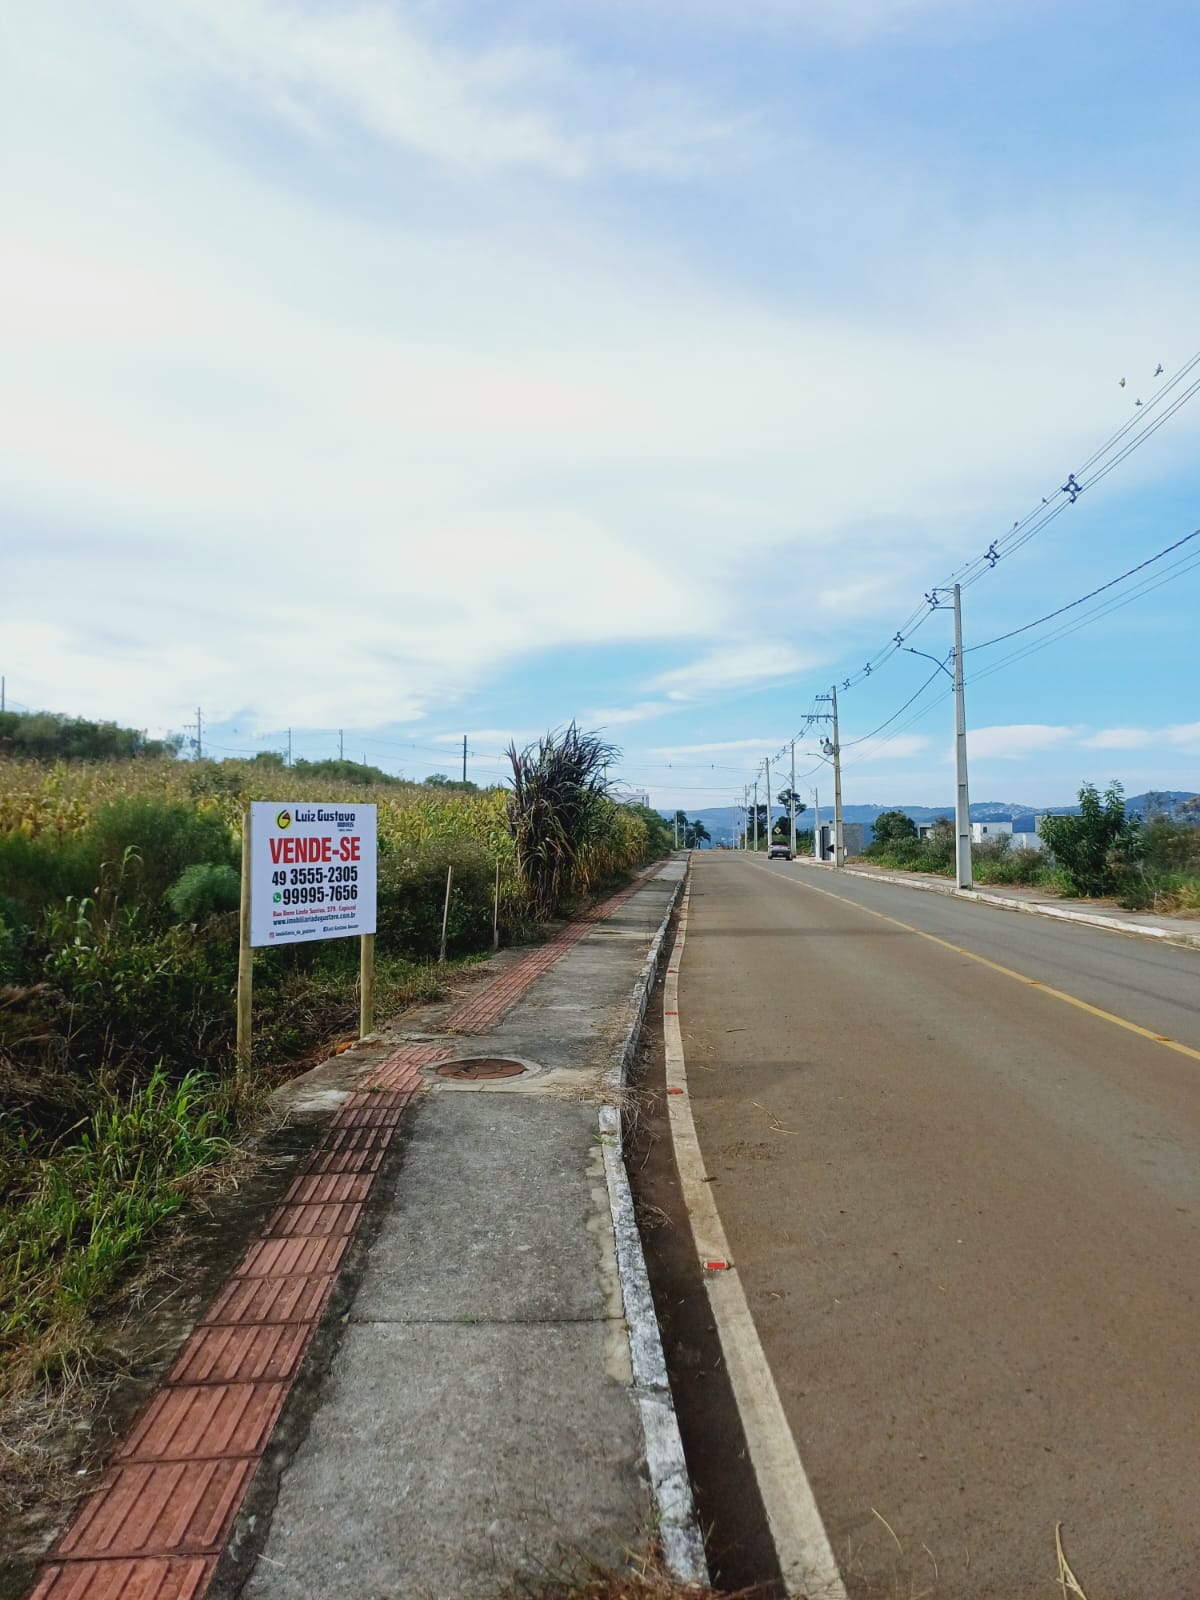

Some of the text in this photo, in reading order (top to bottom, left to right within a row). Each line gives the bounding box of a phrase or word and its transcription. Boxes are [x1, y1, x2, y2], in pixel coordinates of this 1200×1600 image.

[295, 809, 356, 822] Luiz Gustavo
[269, 837, 361, 864] VENDE-SE
[272, 866, 358, 886] 49 3555-2305
[283, 884, 358, 905] 99995-7656
